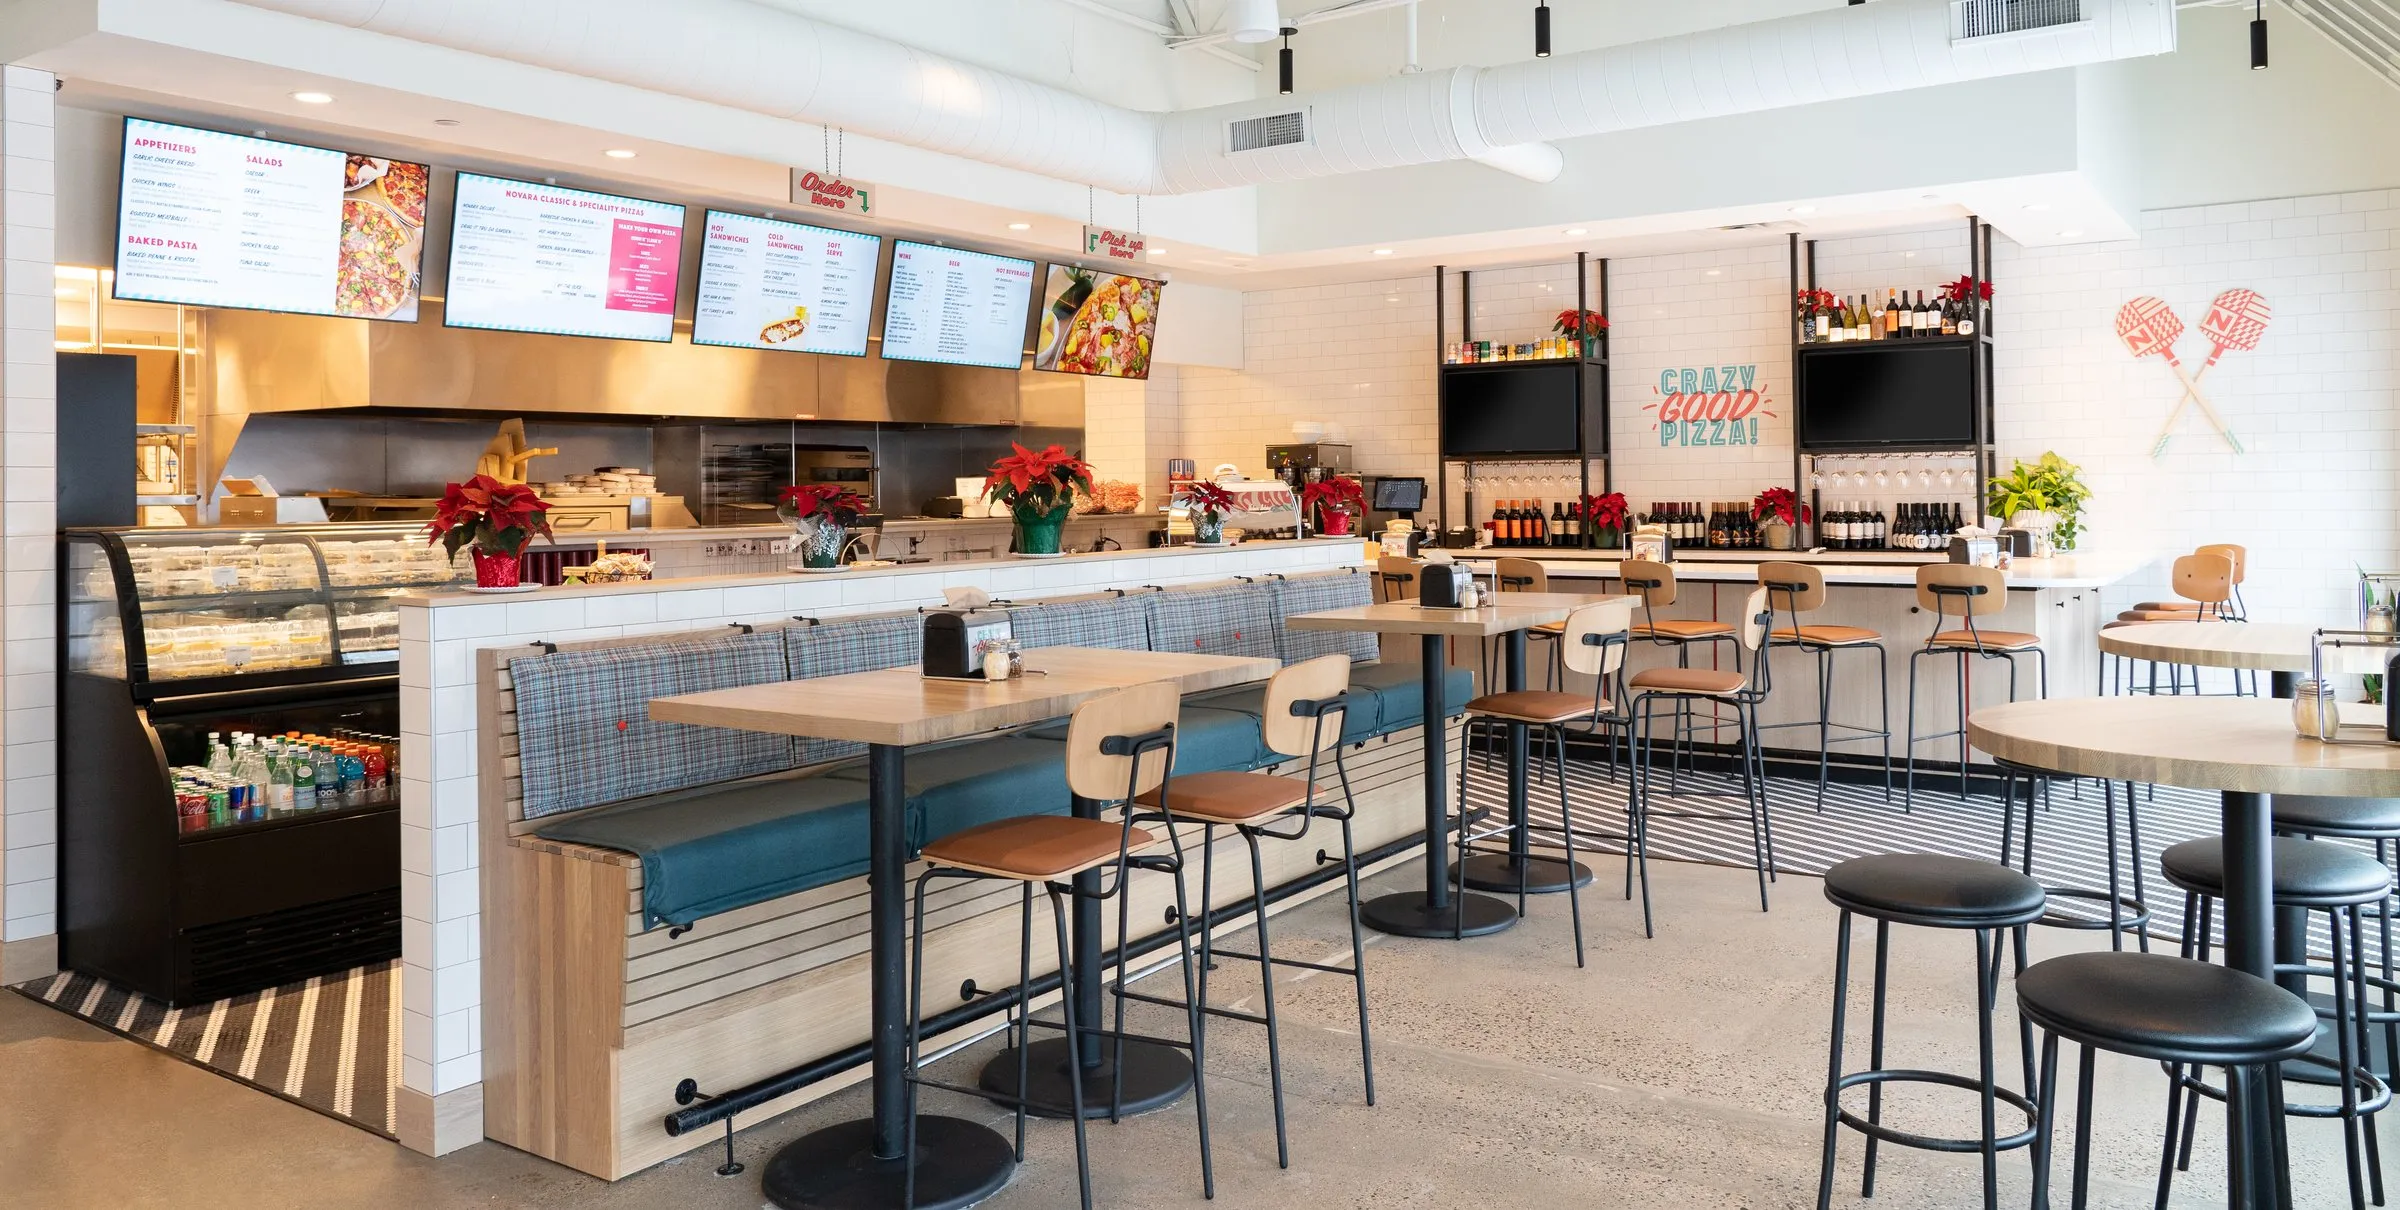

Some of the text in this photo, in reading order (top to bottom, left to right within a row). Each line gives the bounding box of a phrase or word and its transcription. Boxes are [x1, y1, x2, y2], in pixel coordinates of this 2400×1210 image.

[134, 137, 197, 154] APPETIZERS
[246, 154, 283, 167] SALADS
[800, 171, 854, 199] Order
[505, 189, 538, 203] NOVARA
[540, 195, 570, 207] CLASSIC
[579, 200, 619, 214] SPECIALITY
[620, 206, 645, 217] PIZZAS
[811, 192, 845, 209] Here
[128, 235, 197, 250] BAKED PASTA
[710, 232, 749, 244] SANDWICHES
[768, 233, 783, 241] COLD
[1099, 230, 1143, 252] Pick up
[767, 241, 803, 251] SANDWICHES
[1109, 246, 1134, 259] Here
[2206, 310, 2233, 331] N
[1660, 365, 1756, 396] CRAZY
[1659, 389, 1759, 423] GOOD
[1660, 417, 1758, 447] PIZZA!
[184, 799, 206, 815] Cola
